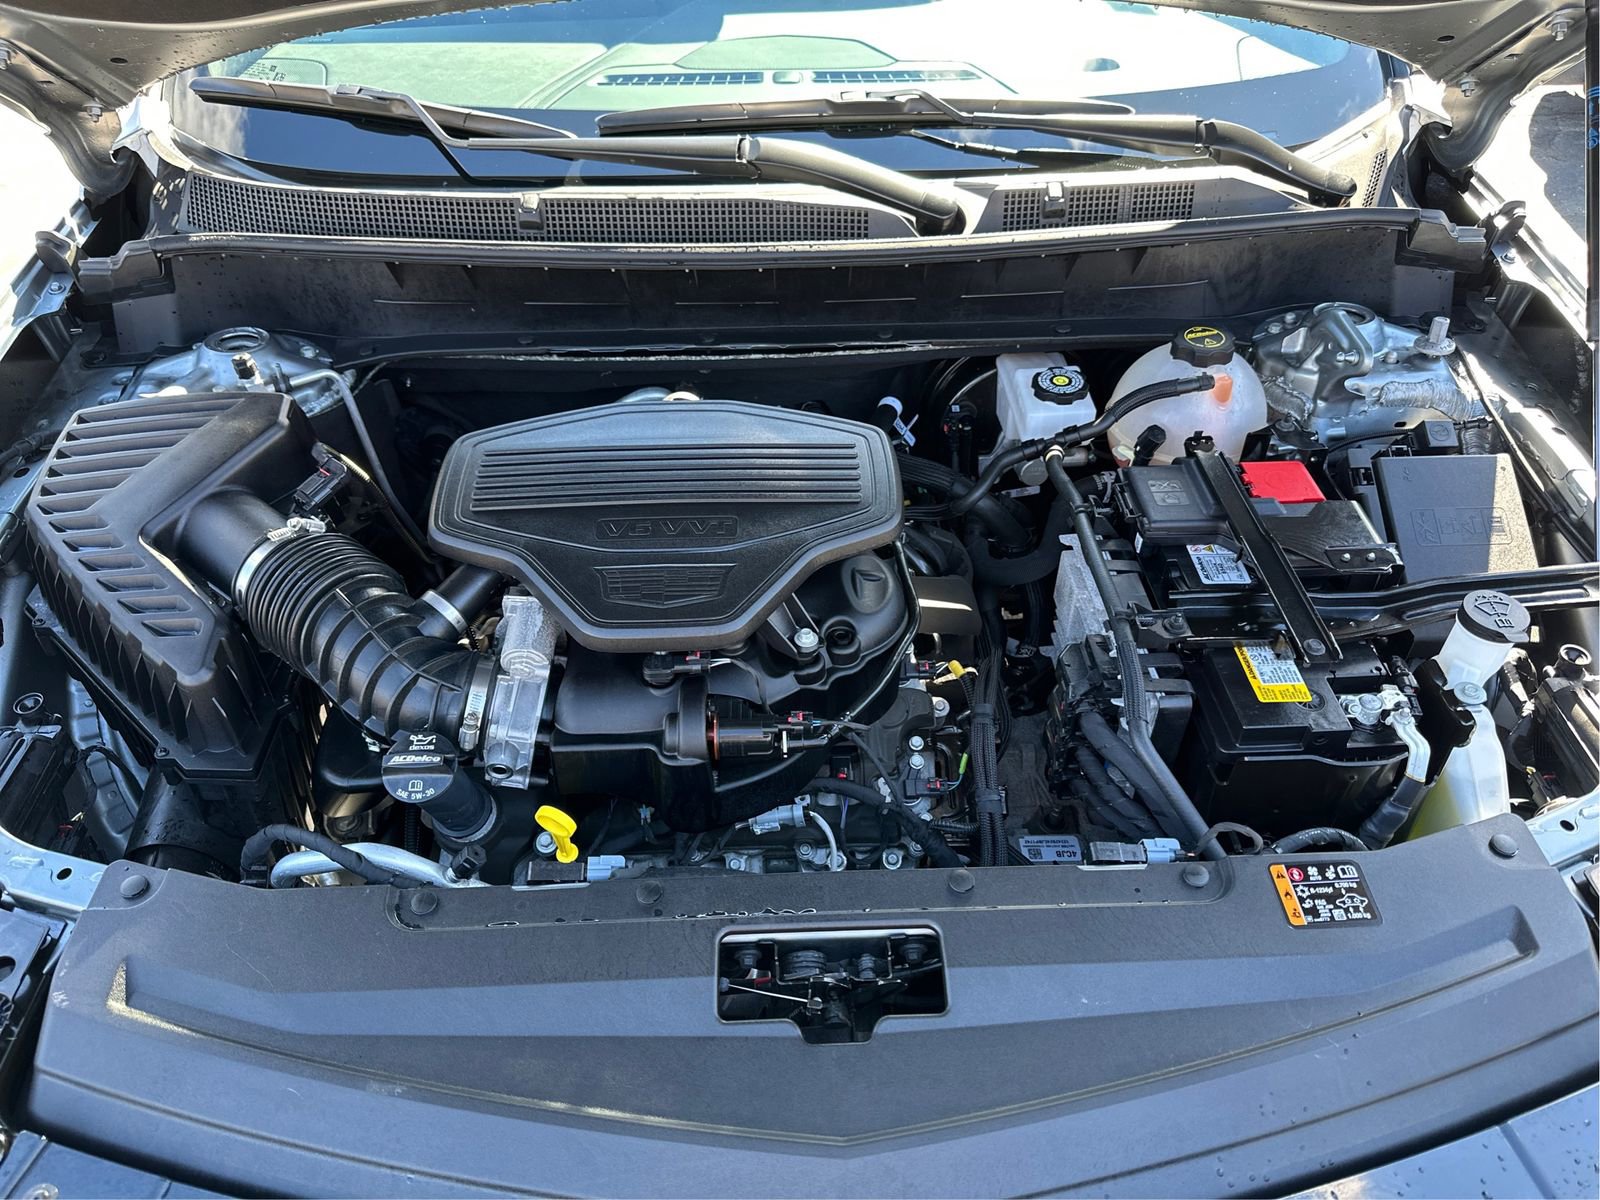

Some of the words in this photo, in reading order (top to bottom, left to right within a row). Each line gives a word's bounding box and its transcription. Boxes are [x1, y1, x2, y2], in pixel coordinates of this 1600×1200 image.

[602, 520, 652, 537] V6
[390, 755, 440, 763] ACDelco
[396, 789, 409, 799] SAE
[411, 788, 435, 799] 5W-30
